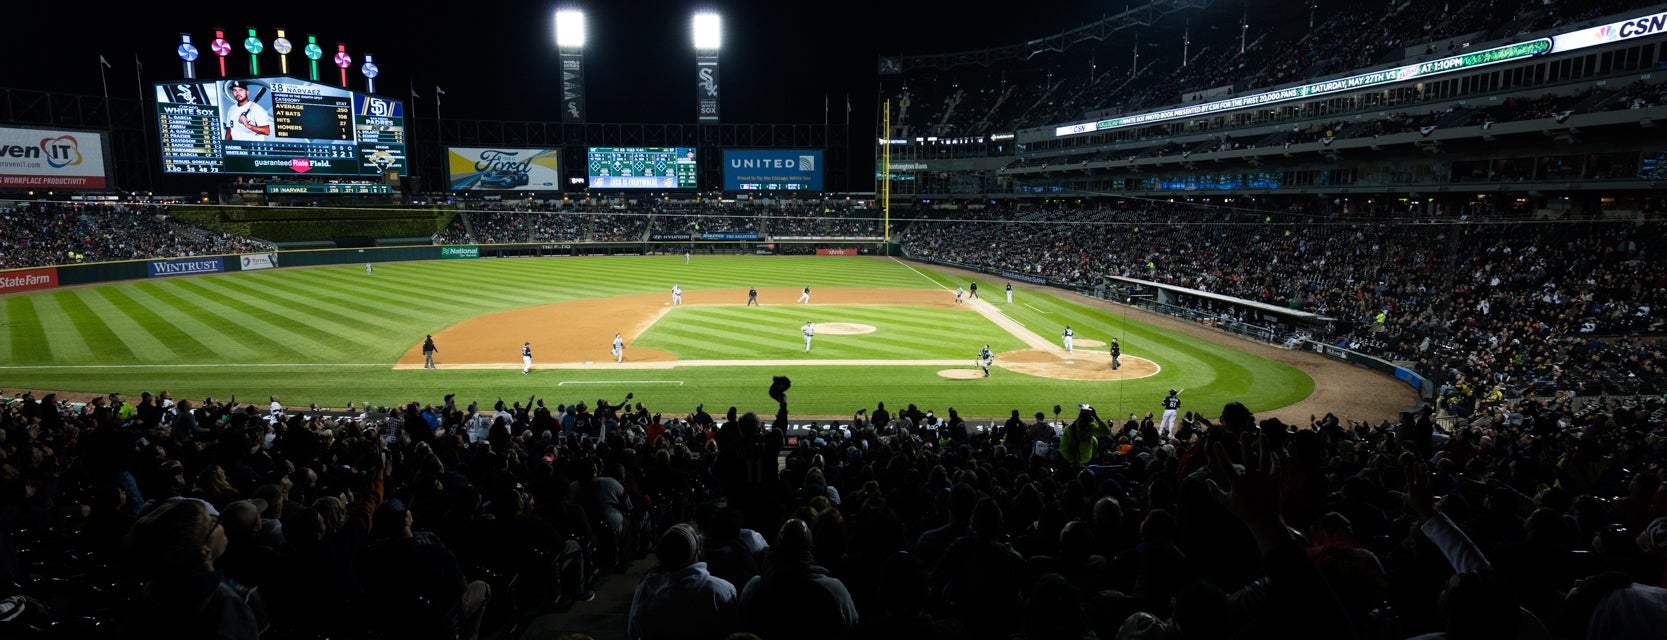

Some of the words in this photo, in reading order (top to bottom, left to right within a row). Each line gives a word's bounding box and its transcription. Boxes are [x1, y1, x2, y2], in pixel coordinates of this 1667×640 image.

[1618, 14, 1667, 38] CSN
[1311, 80, 1347, 93] SATURDAY,
[1348, 77, 1364, 86] MAY
[1365, 73, 1384, 84] 27TH
[1386, 70, 1396, 80] VS
[1421, 64, 1432, 73] AT
[1434, 58, 1463, 70] 1:10PM
[1175, 107, 1200, 116] PRESENTED
[1243, 96, 1258, 105] FIRST
[1260, 93, 1280, 103] 20,000
[52, 145, 70, 159] IT
[474, 150, 533, 173] Ford
[732, 159, 795, 168] UNITED
[154, 260, 218, 272] WINTRUST
[0, 276, 25, 288] State
[26, 275, 49, 285] Farm
